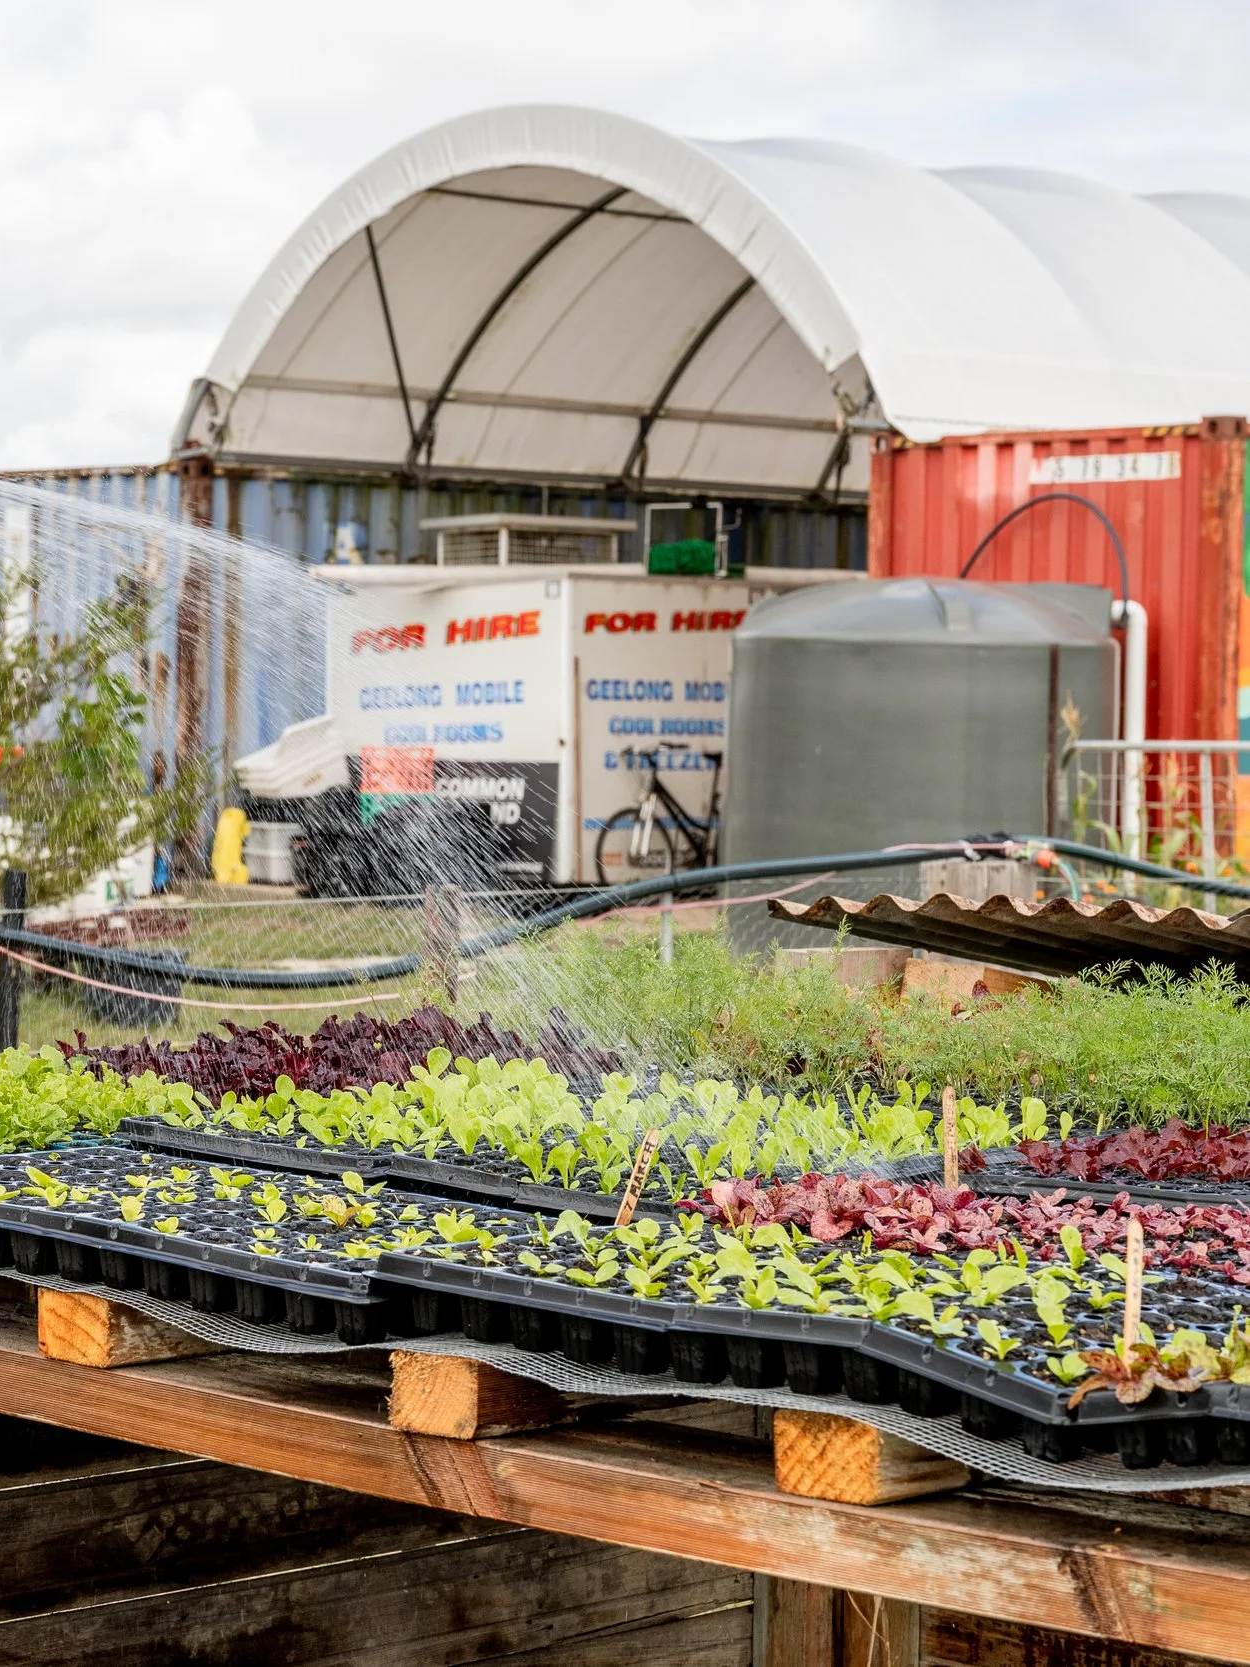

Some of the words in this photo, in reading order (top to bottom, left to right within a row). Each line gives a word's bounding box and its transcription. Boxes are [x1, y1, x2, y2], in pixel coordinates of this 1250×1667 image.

[352, 622, 425, 655] FOR
[446, 609, 540, 646] HIRE
[584, 611, 656, 634] FOR
[456, 679, 524, 706] MOBILE
[586, 679, 673, 702] GEELONG
[684, 680, 726, 702] MOB
[609, 716, 654, 735] COOL
[659, 718, 725, 736] ROOMS
[435, 777, 526, 800] COMMON
[630, 1141, 655, 1198] MARCH
